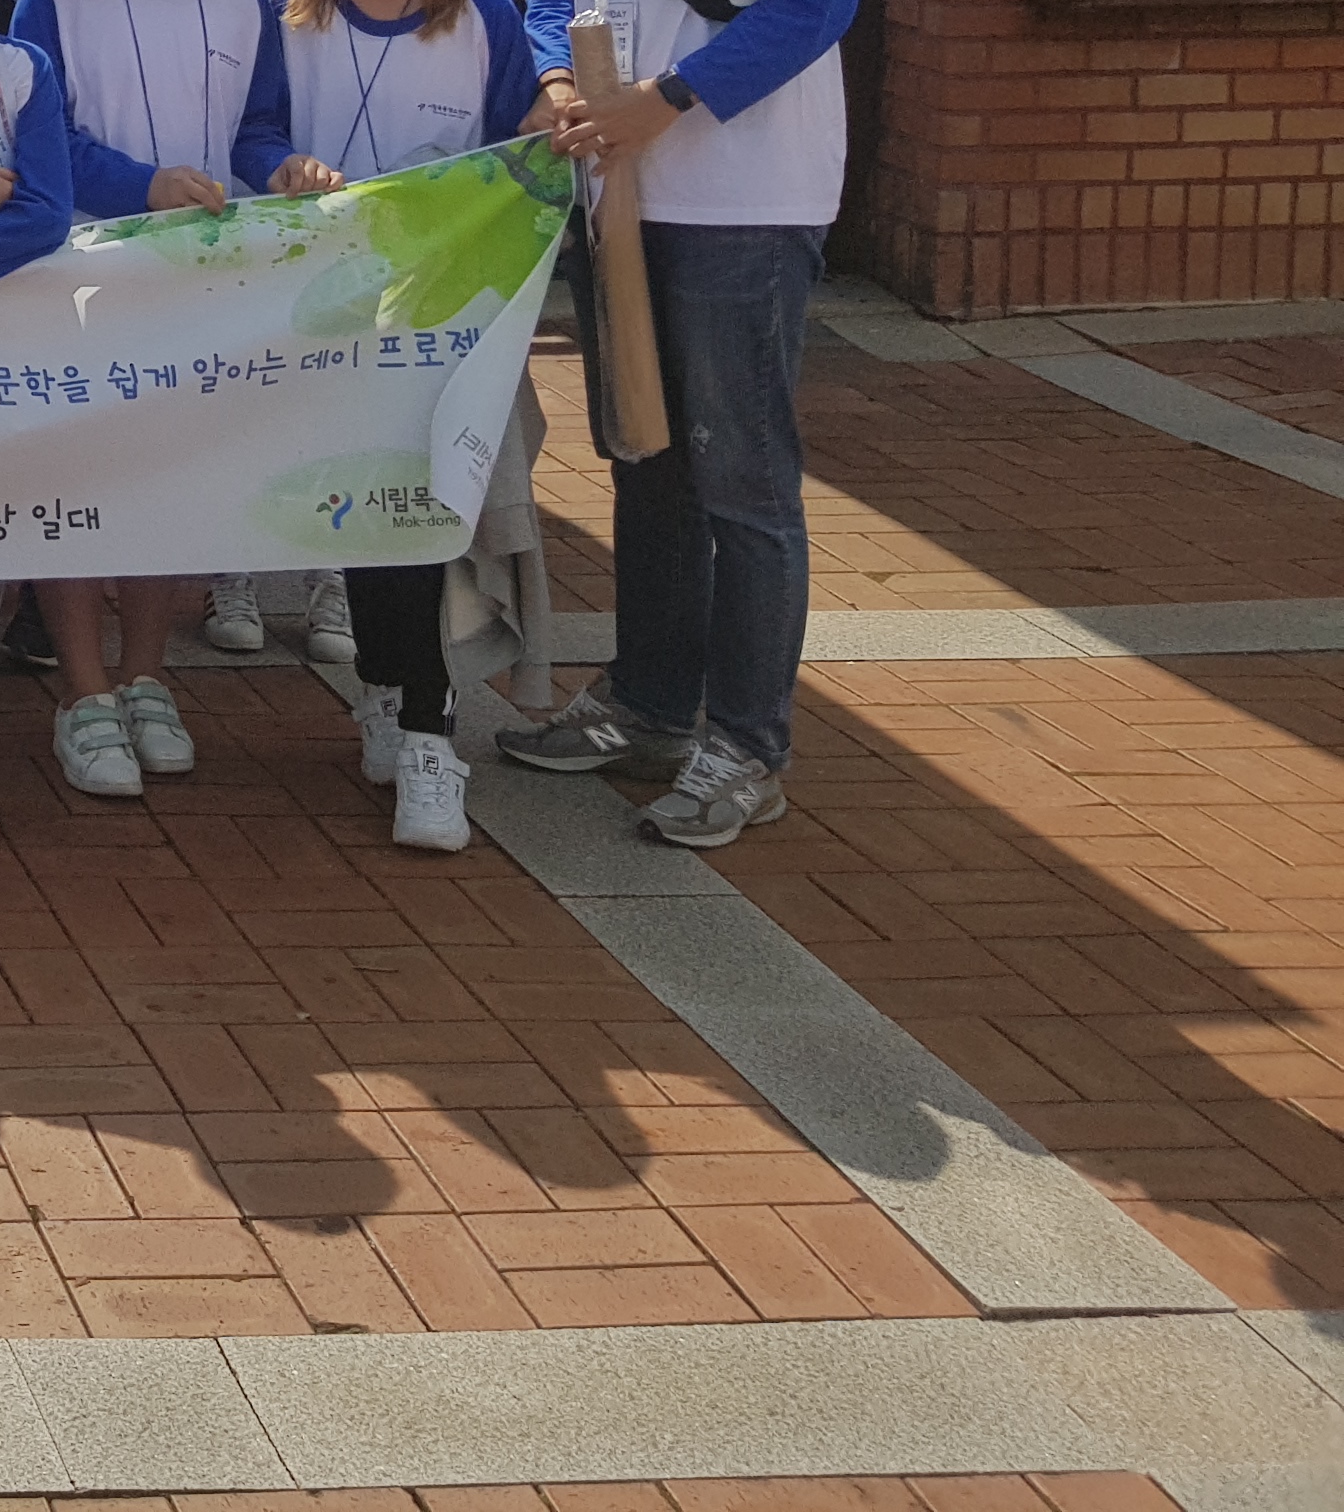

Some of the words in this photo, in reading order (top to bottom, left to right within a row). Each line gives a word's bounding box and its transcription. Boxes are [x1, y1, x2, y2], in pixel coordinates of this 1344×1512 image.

[107, 361, 177, 400] 쉽게
[192, 349, 287, 394] 알아는
[300, 341, 359, 372] 데이
[377, 327, 481, 368] 프로젝
[365, 486, 451, 513] 시립목
[32, 497, 101, 539] 일대
[392, 515, 461, 529] Mok-dong
